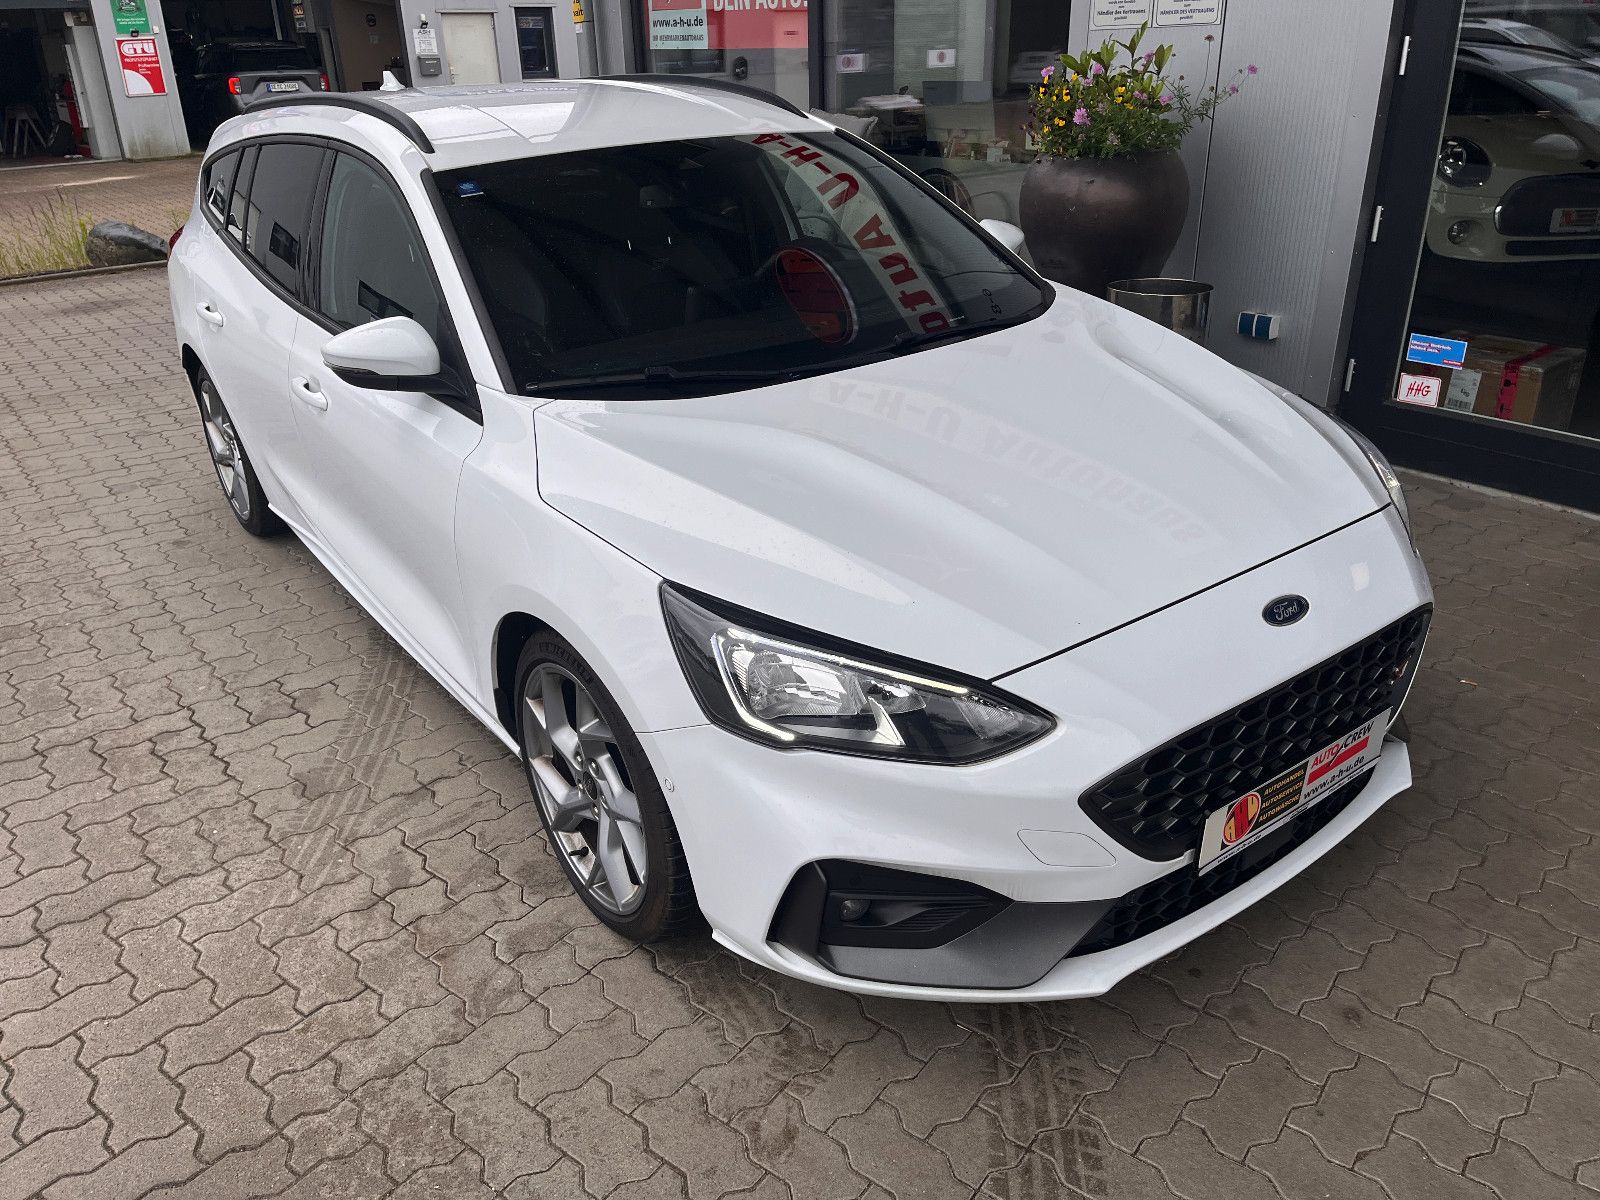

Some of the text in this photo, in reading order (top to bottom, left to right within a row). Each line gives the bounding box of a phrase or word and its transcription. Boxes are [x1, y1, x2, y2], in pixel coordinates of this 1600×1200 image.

[653, 16, 704, 27] www.a-h-u.de
[1406, 381, 1431, 397] HHG
[1273, 602, 1299, 620] Ford
[1304, 755, 1365, 799] www.a-h-u.de
